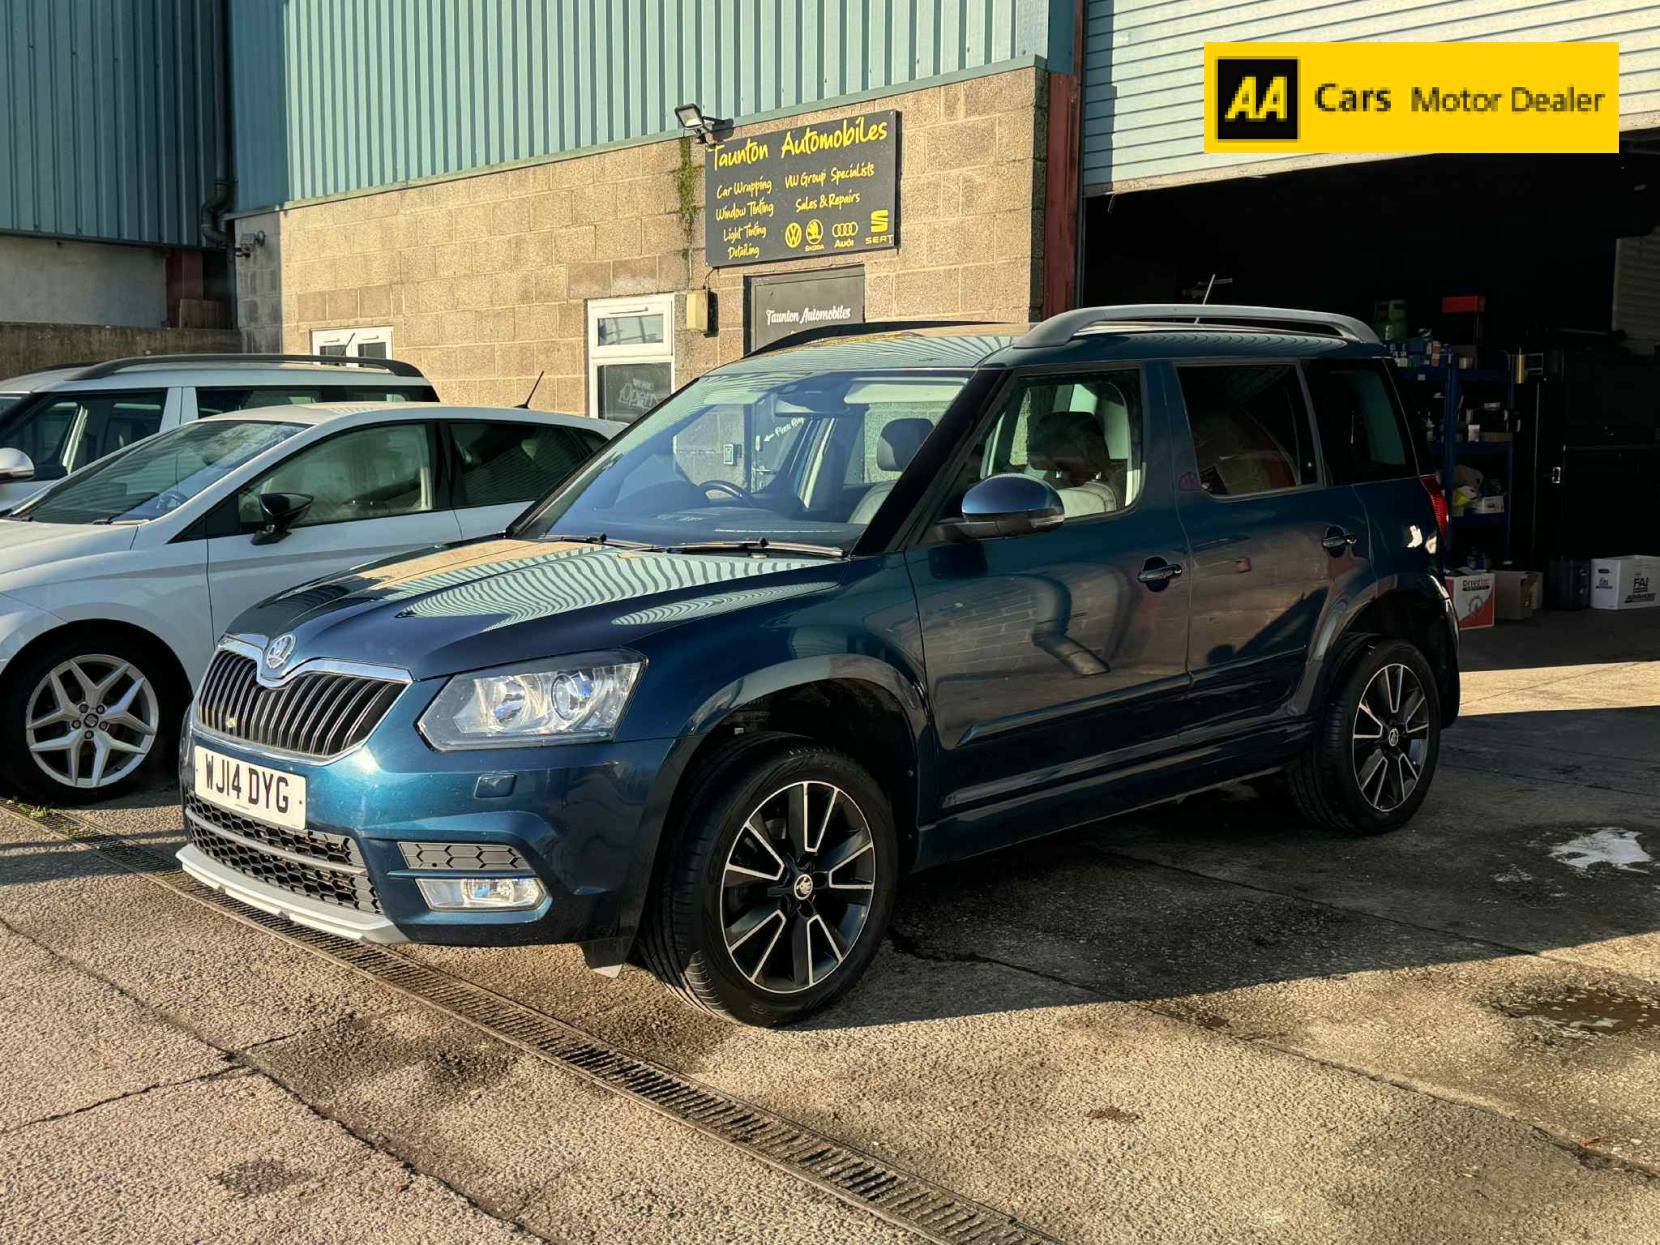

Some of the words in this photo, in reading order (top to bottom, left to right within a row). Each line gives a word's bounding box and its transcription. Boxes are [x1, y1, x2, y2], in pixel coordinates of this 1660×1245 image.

[708, 138, 769, 171] Taunton
[781, 117, 888, 159] Automobiles
[800, 171, 827, 188] Group
[830, 161, 875, 186] Specialists
[716, 185, 732, 199] Car
[733, 176, 773, 198] Wrapping
[715, 202, 746, 221] Window
[747, 196, 774, 217] Tinting
[795, 196, 818, 213] Sales
[819, 194, 828, 209] &
[828, 188, 861, 210] Repairs
[723, 226, 743, 244] Light
[743, 220, 767, 239] Tinting
[834, 239, 855, 248] Audi
[865, 234, 894, 245] SEAT
[728, 242, 760, 260] Detailing
[766, 308, 800, 326] Taunton
[800, 304, 852, 324] Automobiles
[205, 753, 242, 800] WJ14
[248, 767, 289, 814] DYG
